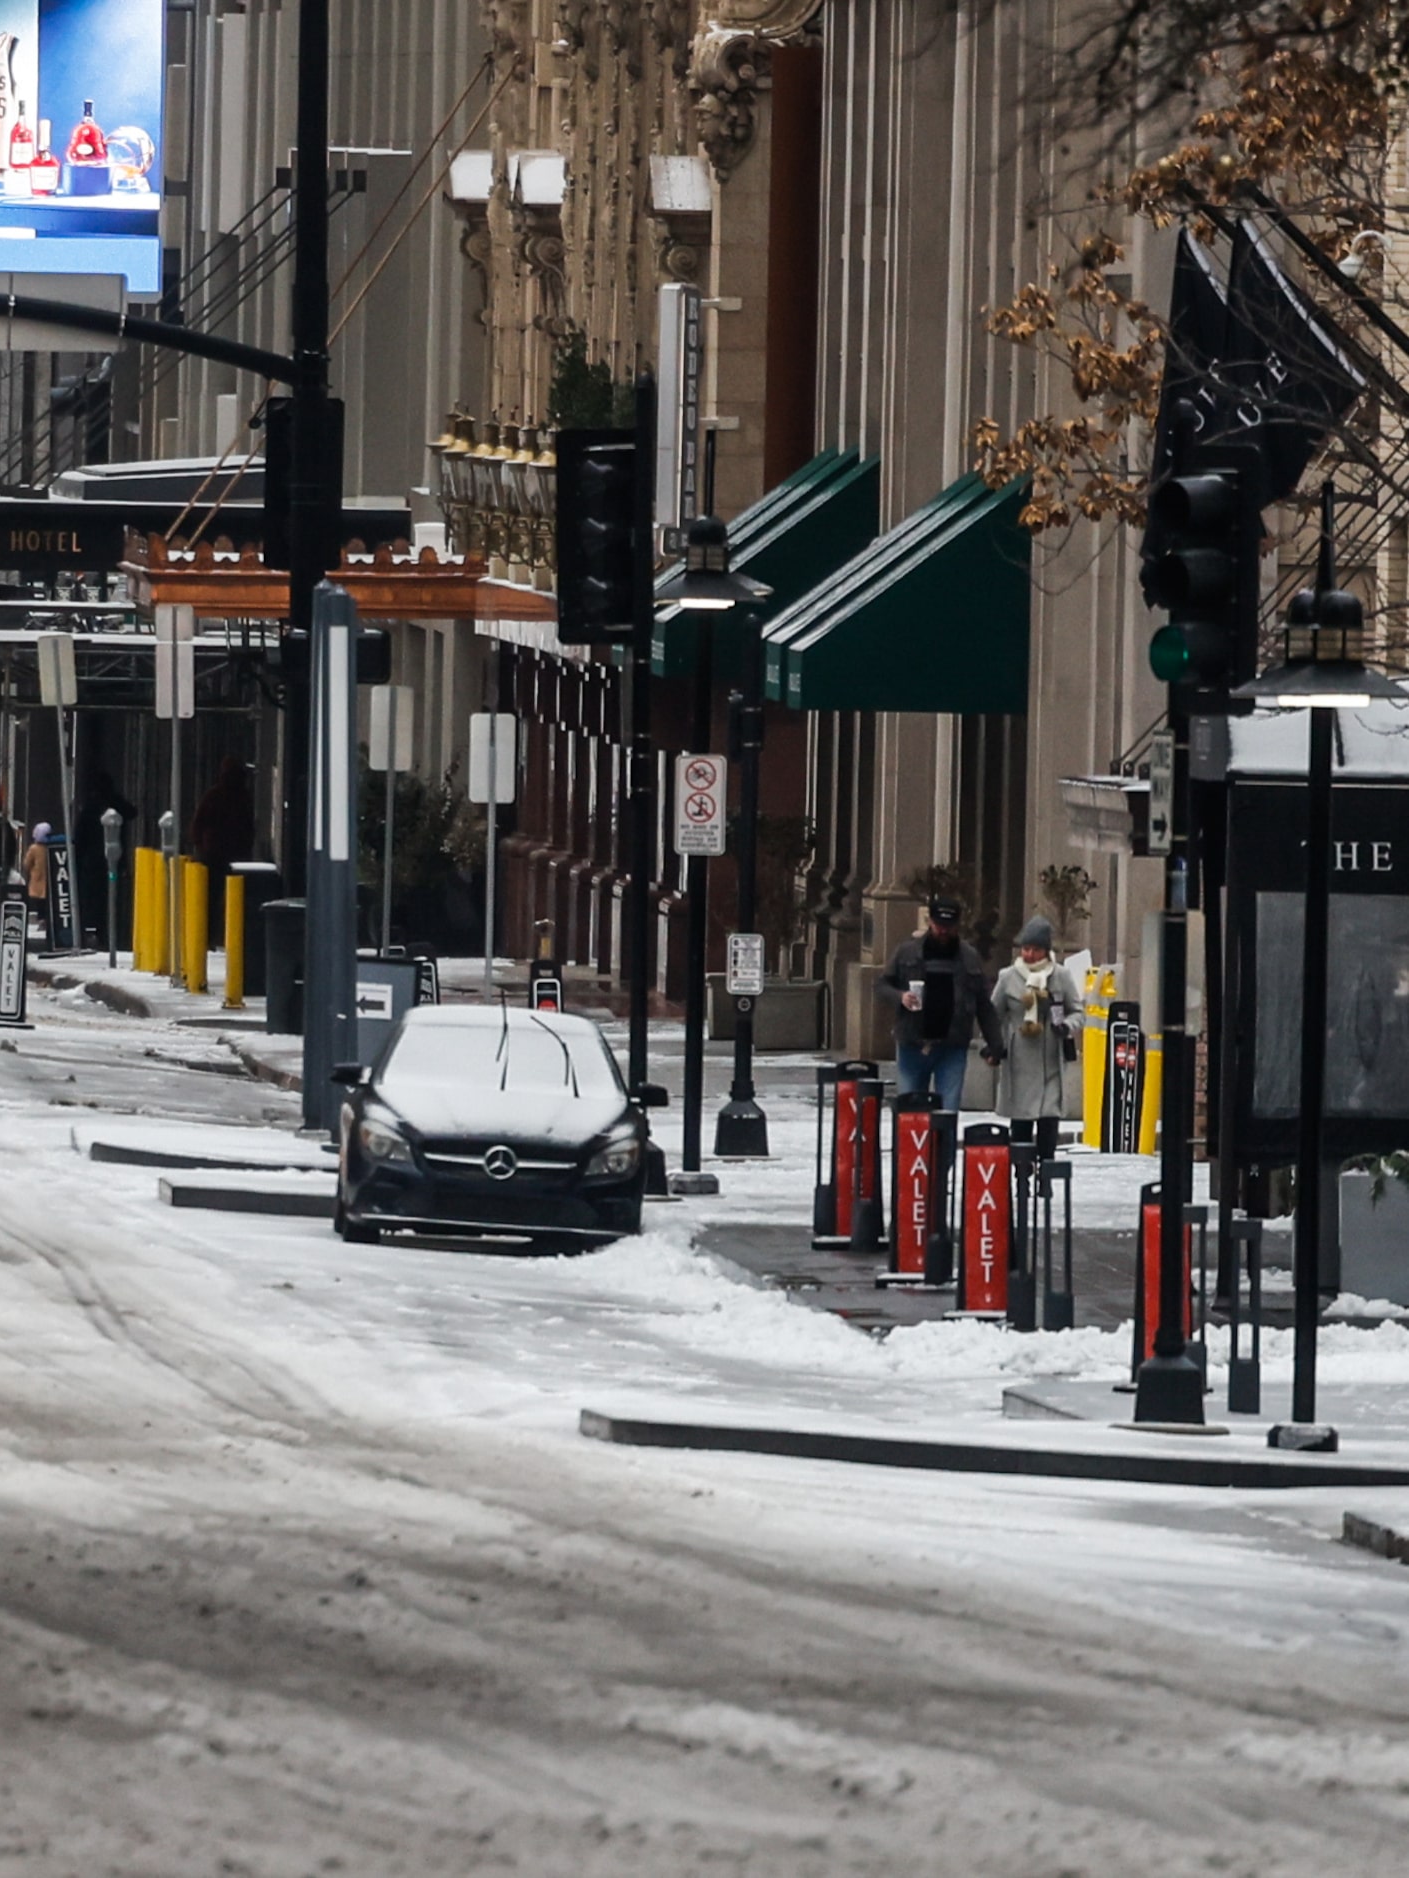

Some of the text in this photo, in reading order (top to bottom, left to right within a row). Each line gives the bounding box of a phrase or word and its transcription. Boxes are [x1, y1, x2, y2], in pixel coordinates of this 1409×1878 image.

[10, 530, 82, 552] HOTEL
[1300, 840, 1393, 871] HE
[55, 851, 70, 928] VALET
[6, 949, 15, 1007] VALET
[910, 1130, 929, 1246] VALET
[977, 1163, 996, 1283] VALET
